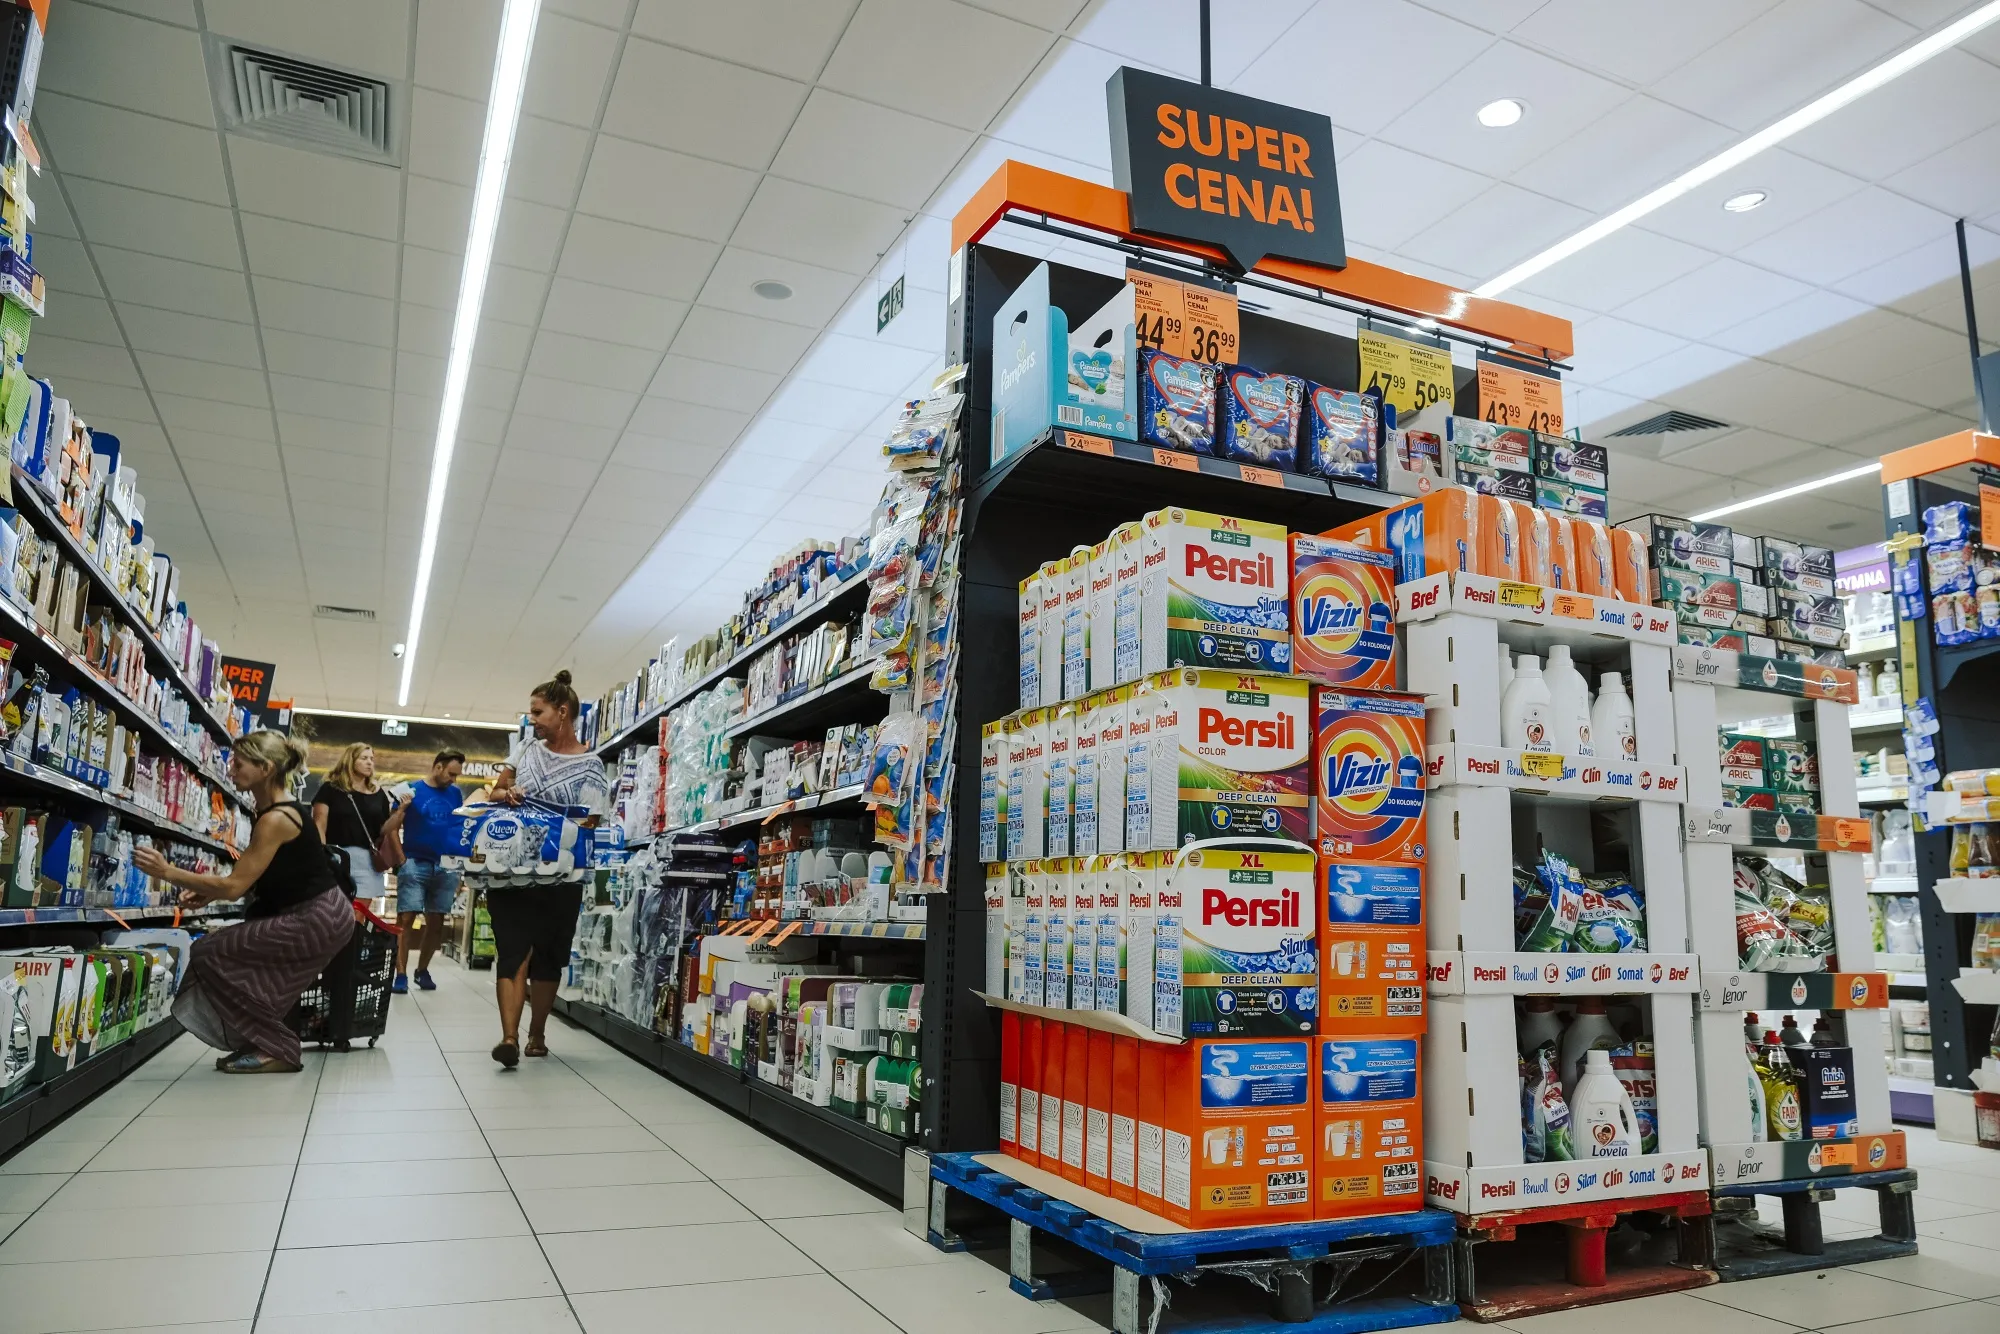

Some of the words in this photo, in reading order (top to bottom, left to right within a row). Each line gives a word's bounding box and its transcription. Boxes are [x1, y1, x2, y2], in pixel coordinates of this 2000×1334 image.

[1157, 103, 1314, 179] SUPER
[1164, 163, 1315, 233] CENA!
[1129, 278, 1153, 289] SUPER
[1135, 289, 1152, 297] ENA!
[1186, 292, 1209, 303] SUPER
[1187, 301, 1208, 311] CENA!
[1136, 312, 1164, 351] 44
[1166, 317, 1182, 333] 99
[1191, 326, 1220, 363] 36
[1220, 332, 1236, 348] 99
[1361, 338, 1387, 349] ZAWSZE
[1362, 346, 1382, 357] NISKIE
[1383, 350, 1400, 360] CENY
[1409, 348, 1434, 360] ZAWSZE
[1079, 360, 1106, 373] Pampers
[1409, 356, 1429, 367] NISKIE
[1429, 361, 1446, 371] CENY
[1000, 352, 1037, 395] Pampers
[1163, 370, 1200, 389] Pampers
[1480, 369, 1499, 379] SUPER
[1393, 376, 1406, 389] 99
[1481, 377, 1498, 386] CENA!
[1523, 379, 1540, 389] SUPER
[1245, 384, 1281, 404] Pampers
[1414, 379, 1438, 411] 59
[1439, 385, 1452, 400] 99
[1523, 387, 1540, 396] CENA!
[1160, 413, 1167, 422] 5
[1325, 401, 1358, 420] Pampers
[1485, 401, 1508, 425] 43
[1508, 404, 1521, 418] 99
[1084, 415, 1112, 430] Pampers
[1240, 423, 1247, 432] 5
[1528, 410, 1550, 433] 43
[1550, 413, 1562, 428] 99
[1069, 437, 1084, 450] 24
[1411, 438, 1438, 455] Somat
[1159, 455, 1173, 466] 32
[1494, 453, 1519, 465] ARIEL
[1244, 471, 1257, 482] 32
[1574, 469, 1597, 481] ARIEL
[1220, 517, 1243, 531] XL
[1185, 543, 1274, 588] Persil
[1695, 556, 1720, 568] ARIEL
[1117, 561, 1138, 582] Persil
[1802, 576, 1824, 589] ARIEL
[1066, 585, 1084, 604] Persil
[1411, 584, 1439, 610] Bref
[1501, 589, 1513, 602] 47
[1256, 596, 1281, 613] Silan
[1464, 586, 1496, 604] Persil
[1600, 609, 1625, 625] Somat
[1649, 619, 1669, 633] Bref
[1021, 605, 1037, 624] Persil
[1303, 597, 1362, 636] Vizir
[1703, 609, 1728, 620] ARIEL
[1203, 623, 1227, 632] DEEP
[1229, 627, 1259, 636] CLEAN
[1813, 626, 1835, 638] ARIEL
[1367, 641, 1392, 651] KOLORÓW
[1695, 658, 1720, 676] Lenor
[1159, 674, 1173, 688] XL
[1237, 676, 1261, 691] XL
[1129, 718, 1150, 736] Persil
[1198, 707, 1294, 750] Persil
[1077, 733, 1096, 749] Persil
[1026, 743, 1043, 758] Persil
[1198, 746, 1227, 756] COLOR
[982, 753, 998, 768] Persil
[1426, 755, 1444, 776] ref
[1527, 761, 1538, 774] 47
[1328, 754, 1391, 798] Vizir
[1467, 757, 1500, 774] Persil
[1582, 767, 1601, 784] Clin
[1607, 771, 1633, 786] Somat
[1658, 776, 1678, 790] Bref
[1728, 769, 1753, 780] ARIEL
[1217, 792, 1243, 801] DEEP
[1245, 793, 1277, 804] CLEAN
[1396, 799, 1422, 807] KOLORÓW
[487, 822, 516, 836] Queen
[1052, 861, 1063, 872] XL
[1240, 854, 1264, 868] XL
[987, 896, 1003, 908] Persil
[1049, 894, 1067, 908] Persil
[1099, 893, 1118, 908] Persil
[1158, 892, 1182, 908] Persil
[1202, 887, 1300, 928] Persil
[1595, 909, 1617, 918] CAPS
[1279, 938, 1308, 957] Silan
[14, 962, 52, 976] FAIRY
[1426, 961, 1451, 981] Bref
[1473, 966, 1506, 981] Persil
[1513, 965, 1538, 981] Perwoll
[1565, 965, 1586, 982] Silan
[1591, 964, 1611, 982] Clin
[1617, 967, 1643, 981] Somat
[1668, 966, 1689, 981] Bref
[1221, 976, 1248, 985] DEEP
[1250, 976, 1282, 985] CLEAN
[1722, 987, 1747, 1005] Lenor
[1792, 987, 1805, 998] FAIRY
[1851, 985, 1867, 1000] Vizir
[1822, 1067, 1846, 1083] finish
[1625, 1073, 1657, 1098] ersi
[1591, 1145, 1628, 1157] Lovela
[1869, 1147, 1885, 1162] Vizir
[1809, 1154, 1821, 1165] FAIR
[1737, 1160, 1763, 1178] Lenor
[1428, 1176, 1460, 1200] Bref
[1481, 1180, 1516, 1199] Persil
[1523, 1177, 1549, 1195] Perwoll
[1576, 1173, 1597, 1191] Silan
[1603, 1169, 1623, 1188] Clin
[1629, 1168, 1656, 1184] Somat
[1681, 1163, 1701, 1179] Bref
